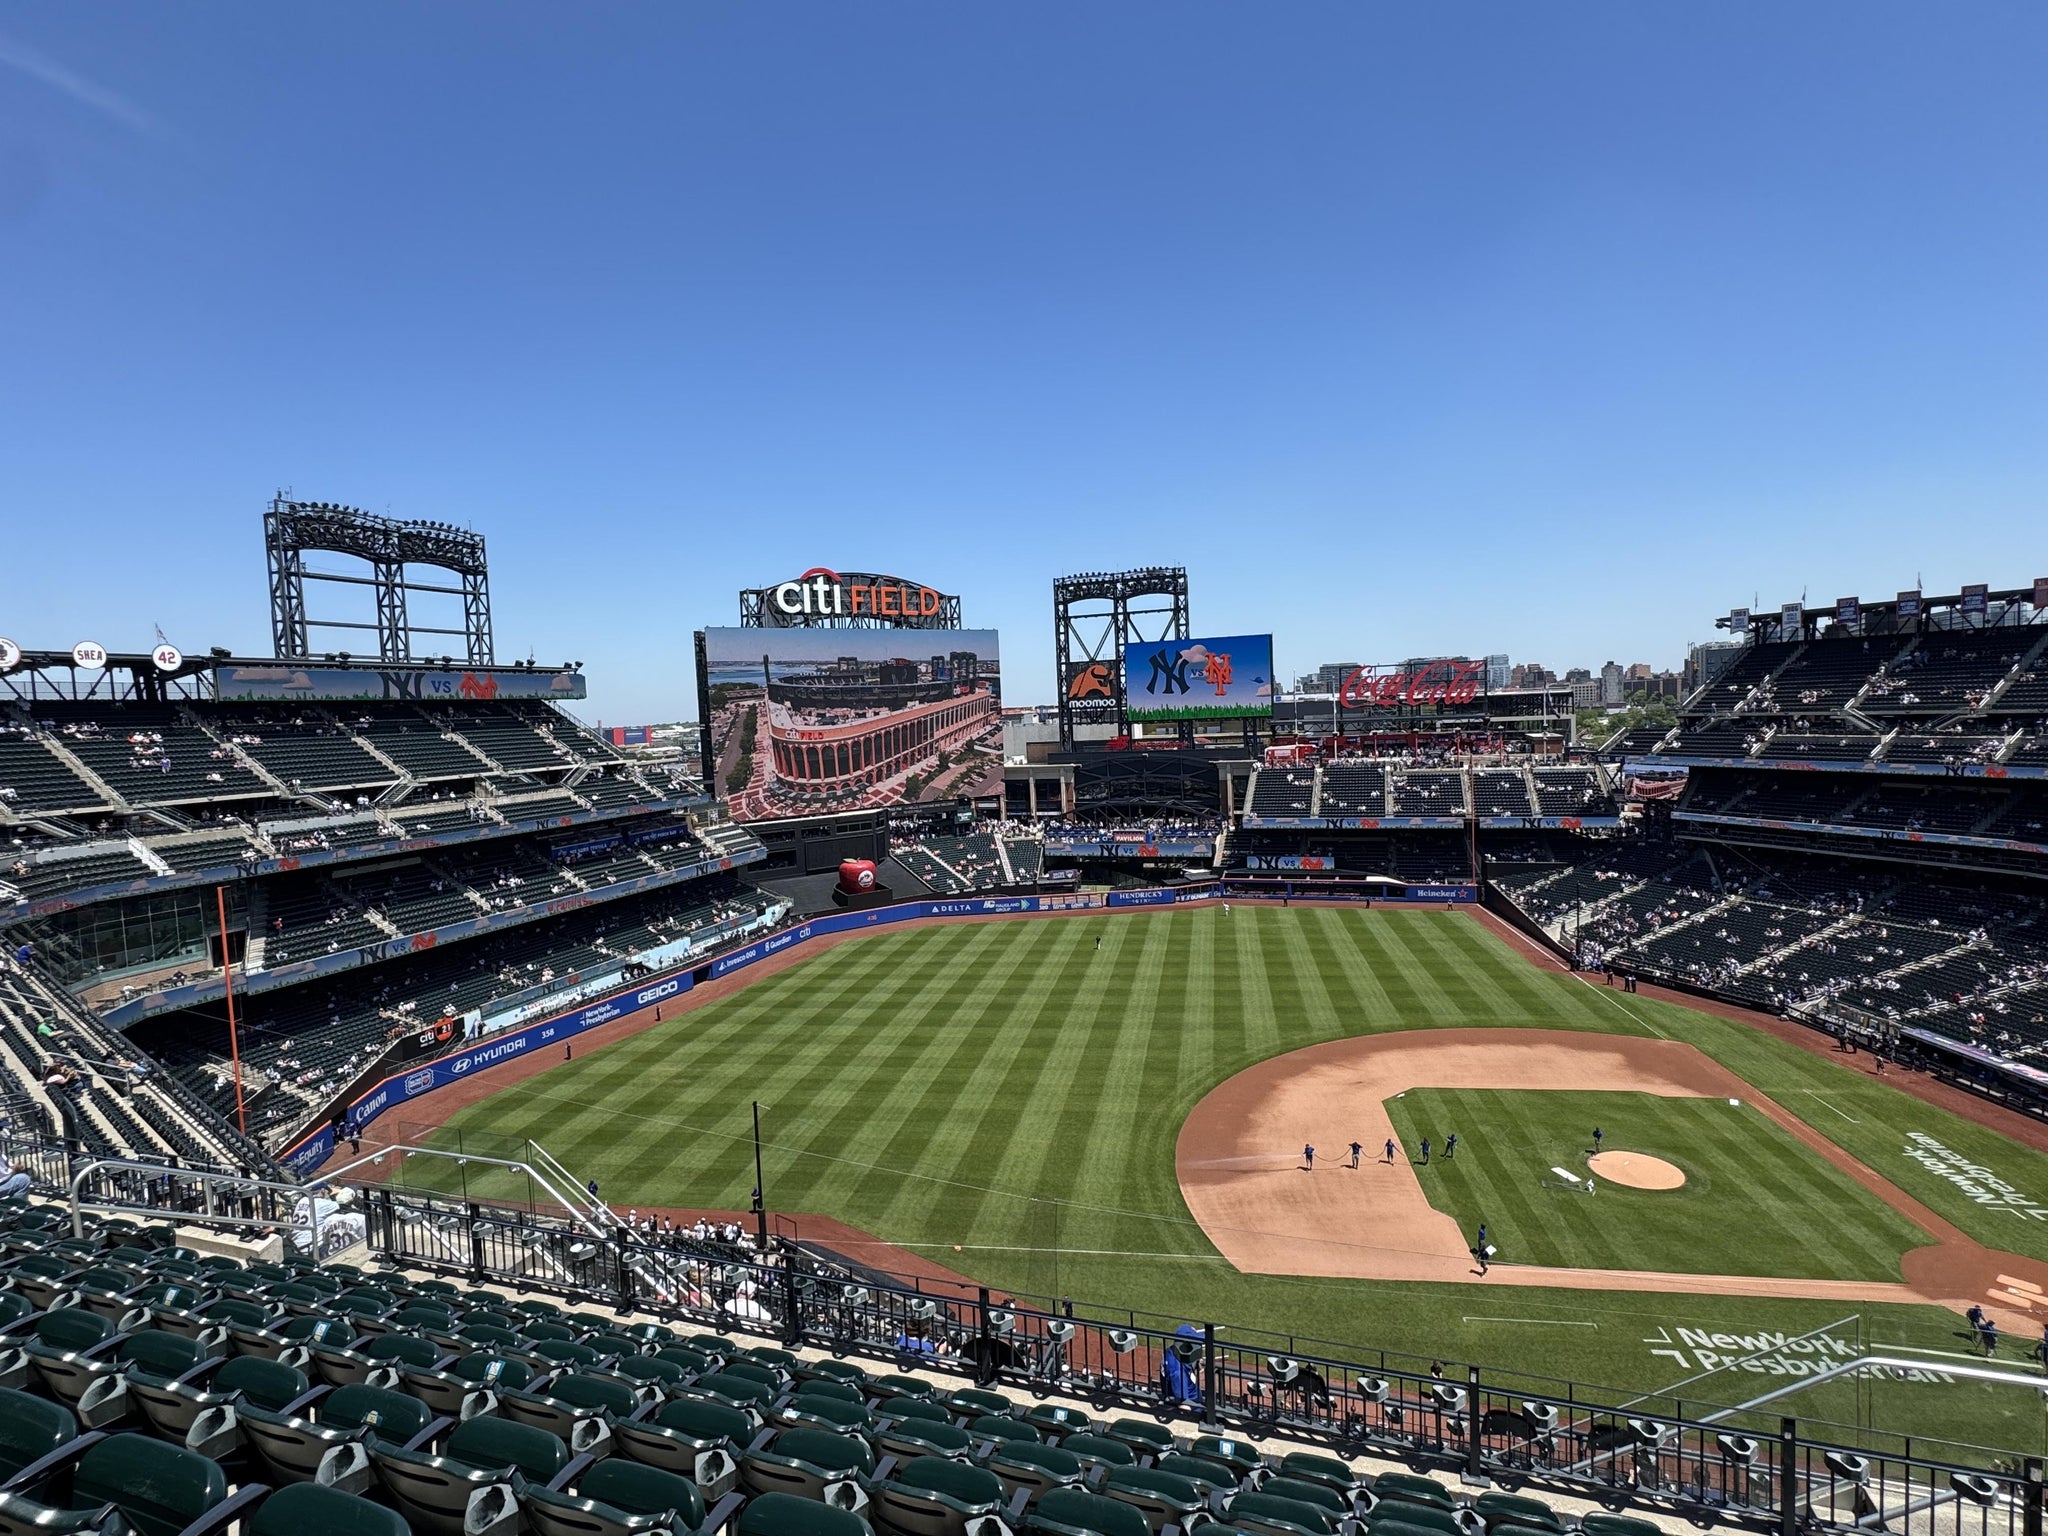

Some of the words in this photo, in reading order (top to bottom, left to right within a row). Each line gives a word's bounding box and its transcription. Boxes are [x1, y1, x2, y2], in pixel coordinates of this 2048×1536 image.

[776, 575, 843, 614] citi
[851, 585, 939, 616] FIELD
[77, 650, 103, 661] SHEA
[158, 651, 177, 664] 42
[431, 680, 451, 693] VS
[1069, 699, 1116, 709] moomoo
[1119, 891, 1163, 899] HENDRICK'S
[1417, 889, 1456, 897] Heineken
[941, 904, 971, 912] DELTA
[799, 925, 811, 938] citi
[392, 943, 406, 953] VS
[770, 934, 792, 949] Guardian
[726, 954, 746, 967] Invesco
[637, 980, 678, 1005] GEICO
[585, 1008, 621, 1026] Presbyterian
[419, 1029, 435, 1044] citi
[541, 1028, 555, 1039] 358
[474, 1038, 526, 1065] HYUNDAI
[355, 1090, 387, 1122] Canon
[1905, 1132, 2039, 1206] Presbyterian
